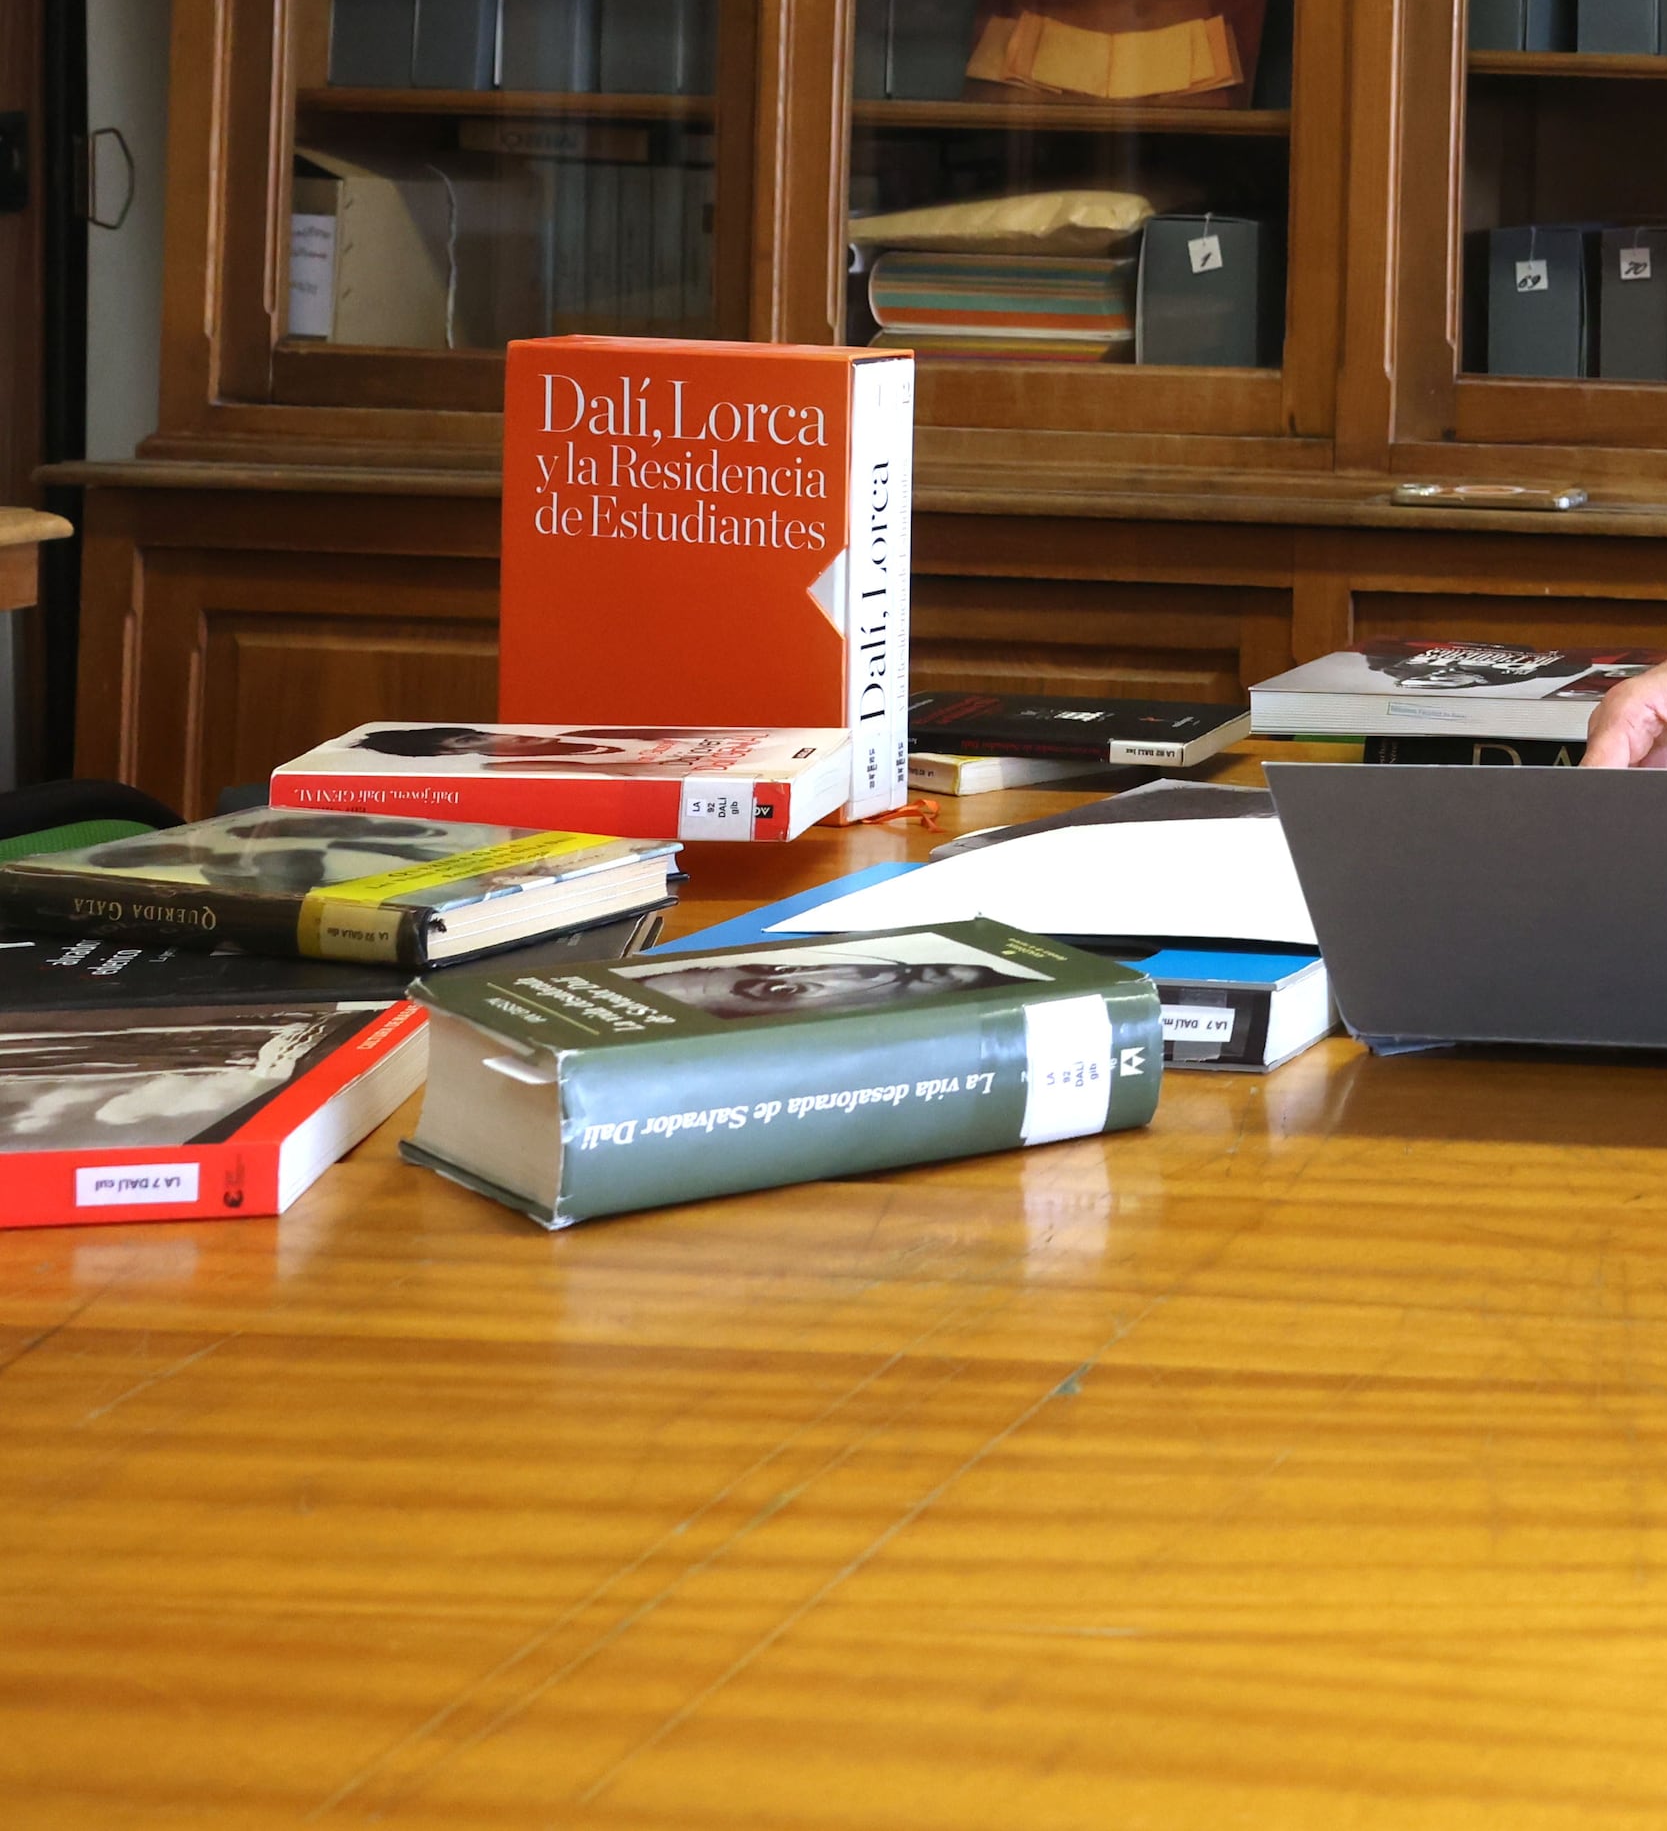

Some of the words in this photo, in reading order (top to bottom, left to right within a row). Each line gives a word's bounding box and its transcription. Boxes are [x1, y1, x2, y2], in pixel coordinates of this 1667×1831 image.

[1199, 252, 1212, 267] 1
[1624, 260, 1648, 276] 70
[1517, 274, 1541, 289] 69
[538, 373, 662, 447] Dalí,
[668, 380, 828, 446] Lorca
[535, 454, 558, 492] y
[566, 442, 599, 486] la
[610, 445, 827, 498] Residencia
[535, 492, 582, 537] de
[590, 496, 826, 551] Estudiantes
[861, 461, 889, 598] Lorca
[860, 609, 889, 722] Dalí,
[294, 789, 354, 802] GENIAL
[358, 790, 386, 803] Dalí
[390, 787, 431, 804] joven.
[431, 791, 459, 804] Dalí
[692, 801, 701, 812] LA
[707, 802, 715, 813] 92
[1206, 1020, 1213, 1030] 7
[1215, 1021, 1228, 1030] LA
[915, 1076, 964, 1102] vida
[966, 1072, 996, 1095] La
[786, 1083, 909, 1118] desaforada
[753, 1099, 780, 1121] de
[640, 1105, 748, 1137] Salvador
[152, 1178, 160, 1188] 7
[164, 1177, 180, 1188] LA
